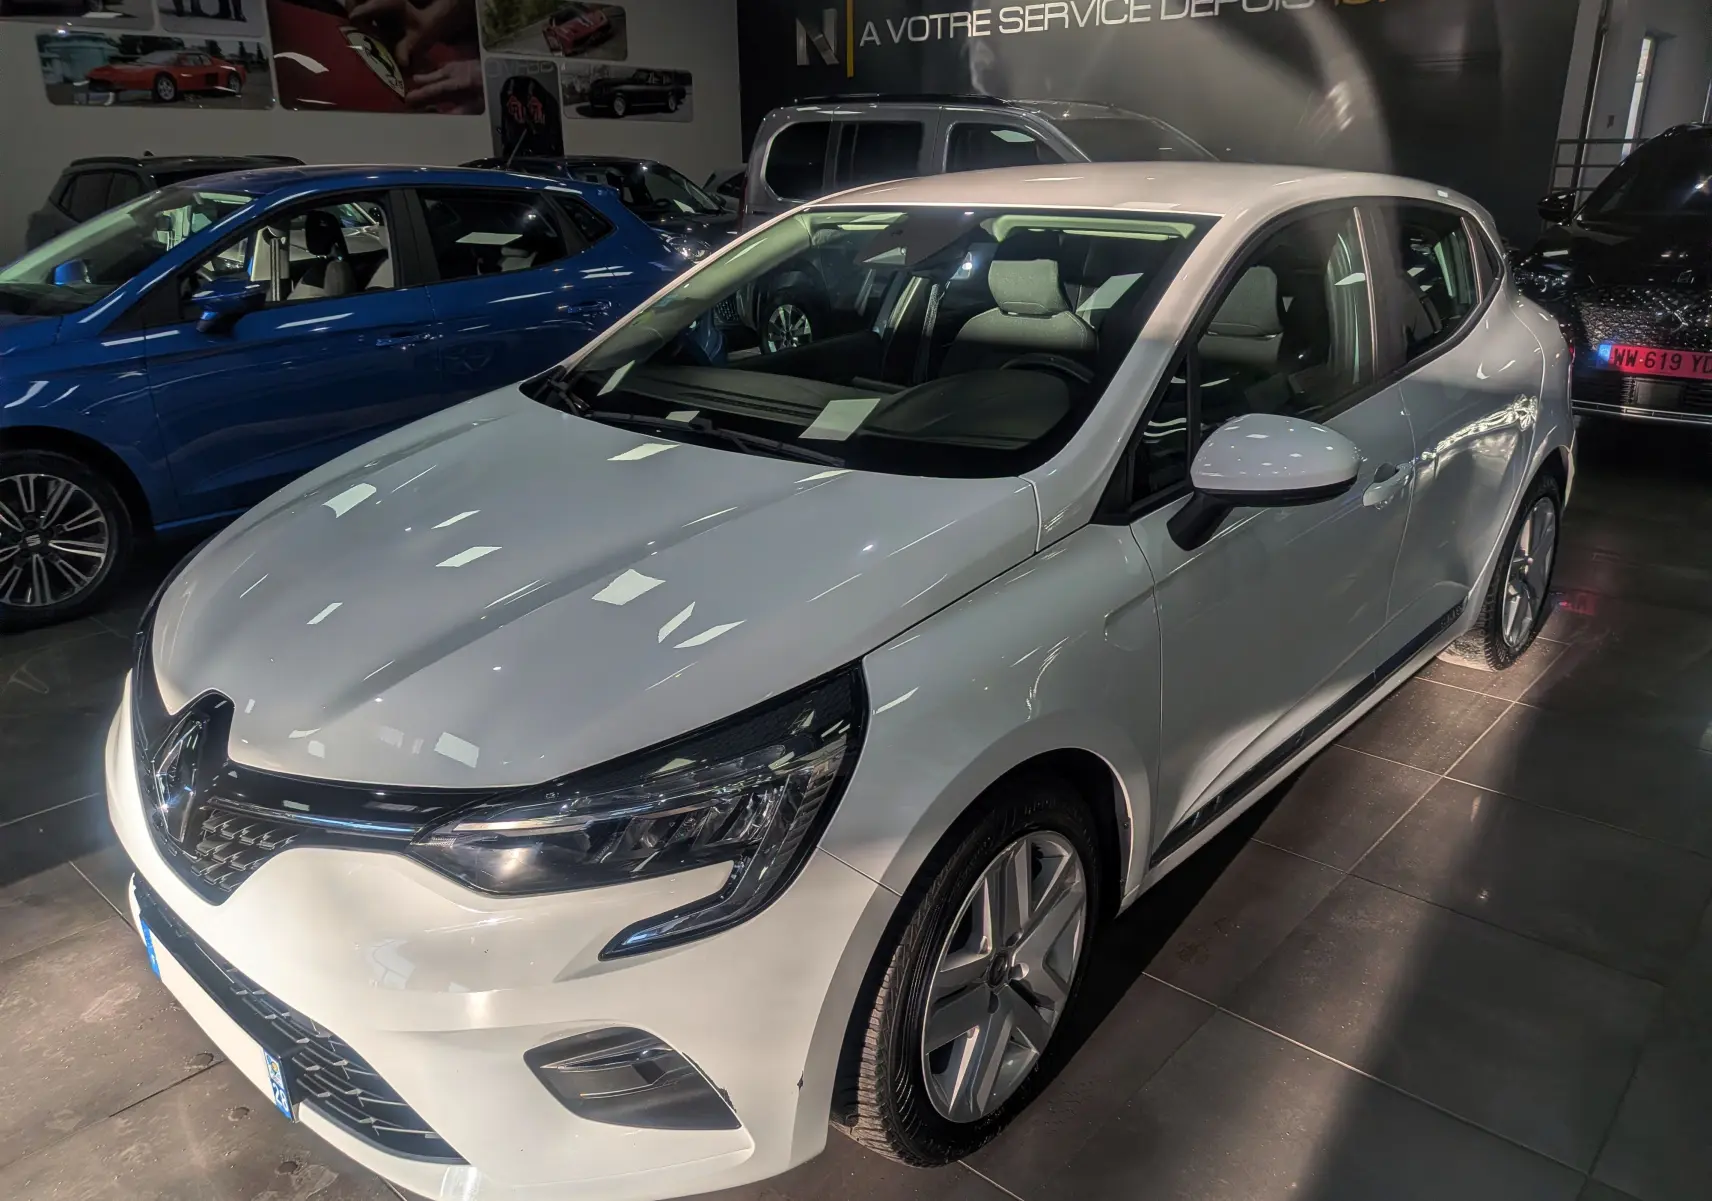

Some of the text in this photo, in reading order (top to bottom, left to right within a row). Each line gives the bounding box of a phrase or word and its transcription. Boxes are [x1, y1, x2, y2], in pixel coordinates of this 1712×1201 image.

[859, 21, 882, 47] A
[886, 9, 992, 44] VOTRE
[998, 0, 1151, 34] SERVICE
[272, 1081, 290, 1113] 28
